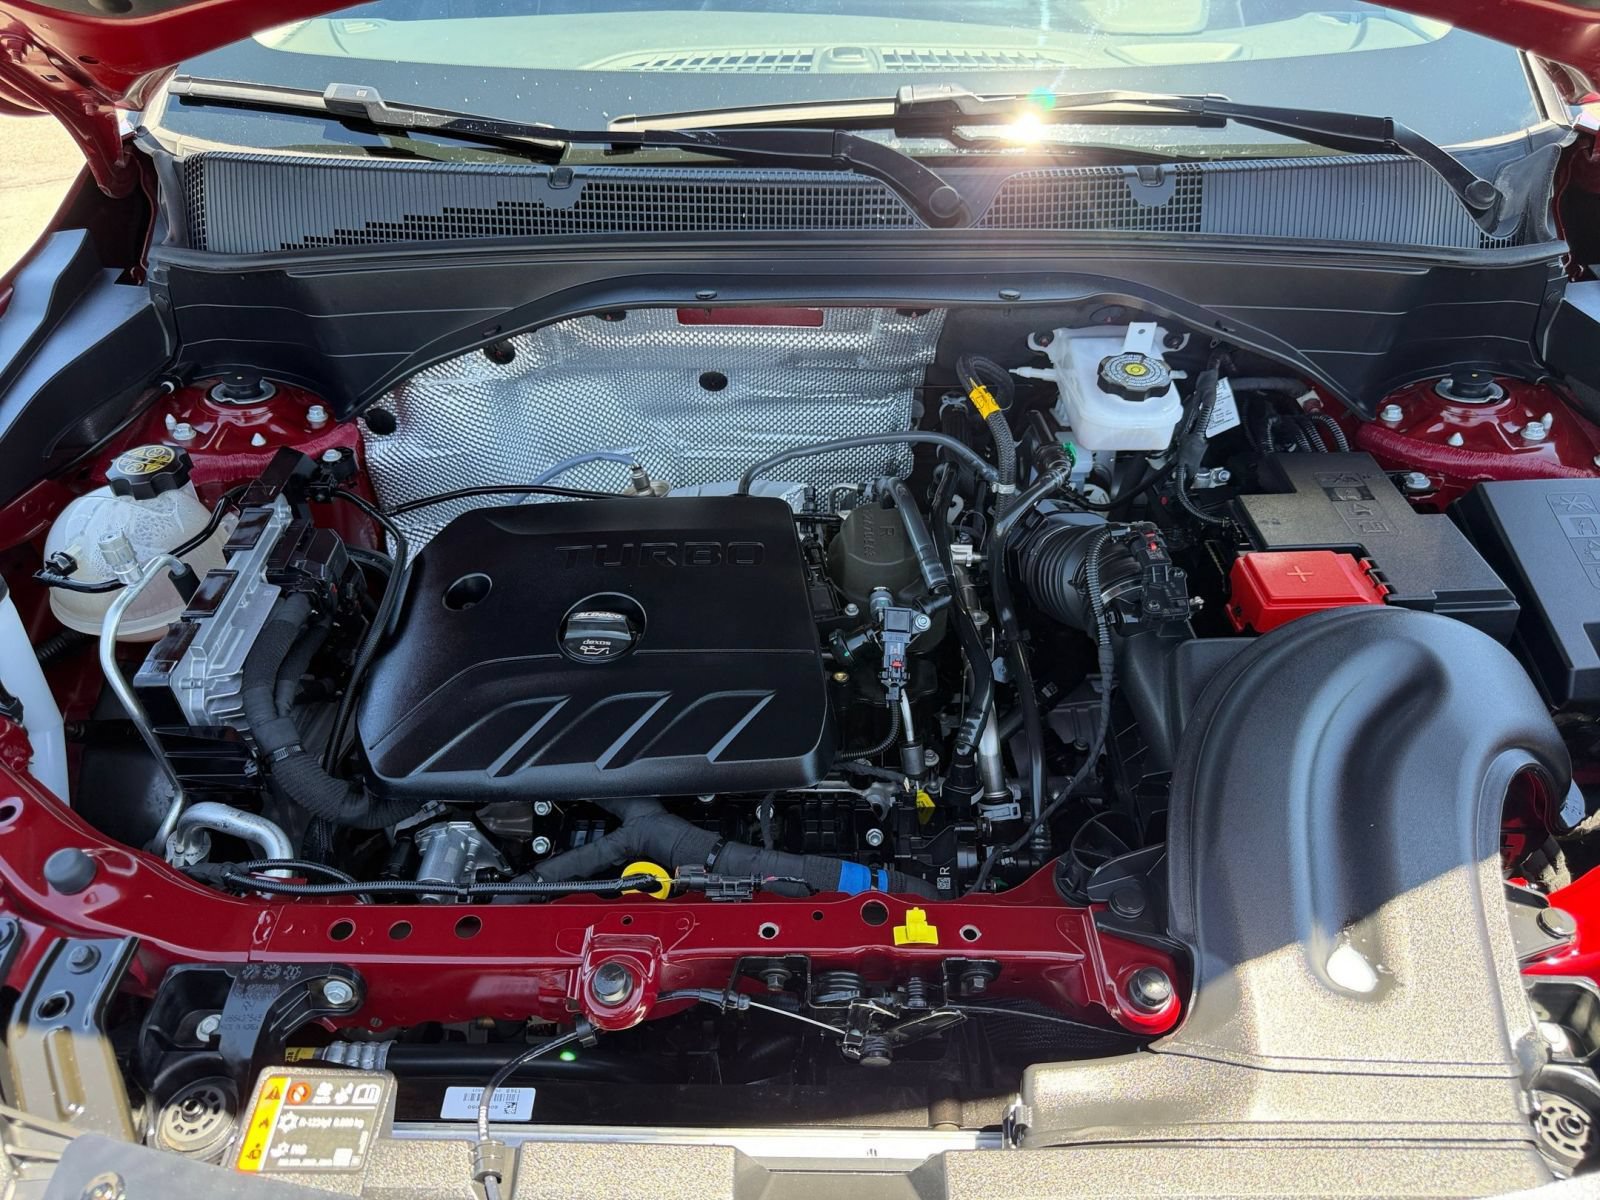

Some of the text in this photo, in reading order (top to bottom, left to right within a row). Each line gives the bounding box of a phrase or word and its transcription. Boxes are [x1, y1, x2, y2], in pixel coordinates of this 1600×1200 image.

[555, 541, 766, 569] TURBO
[575, 611, 623, 619] ACDelco
[582, 638, 611, 646] dexos
[940, 867, 950, 875] R
